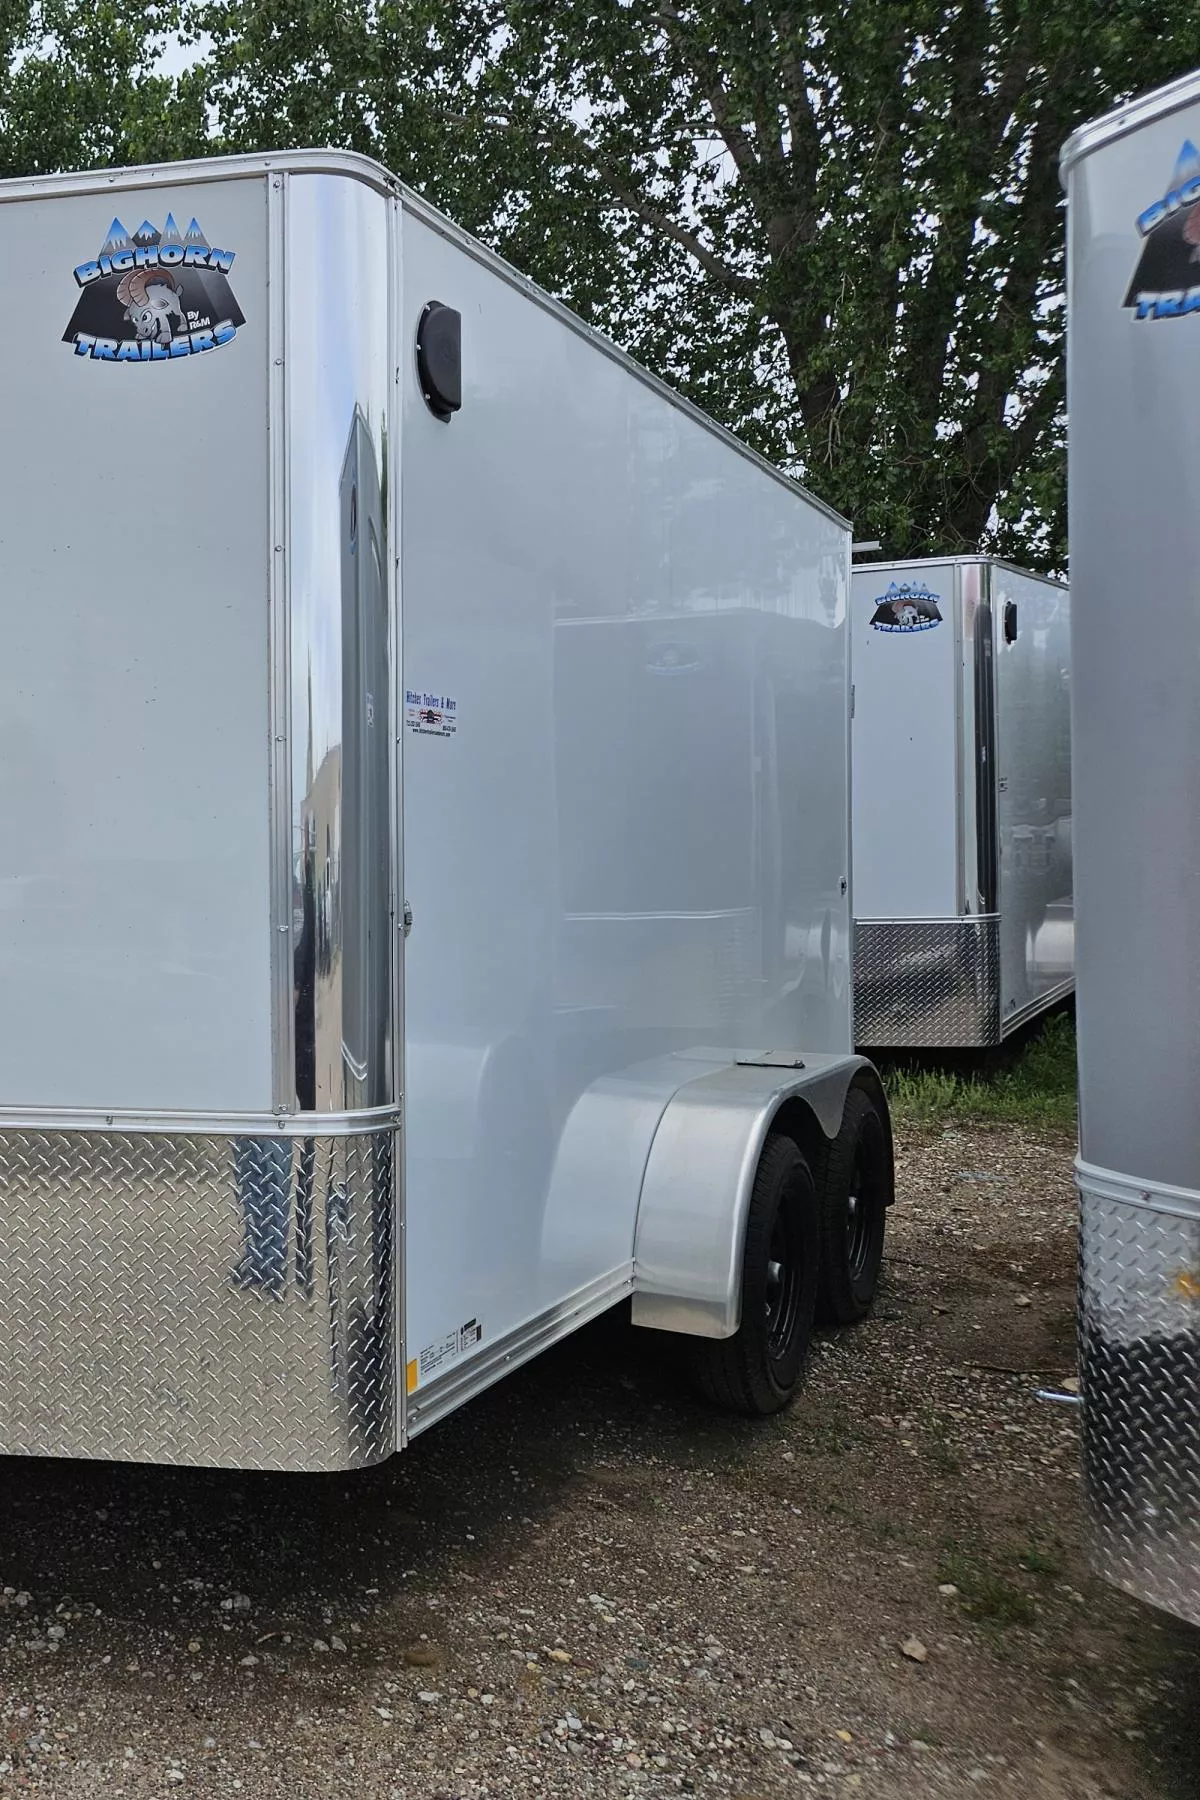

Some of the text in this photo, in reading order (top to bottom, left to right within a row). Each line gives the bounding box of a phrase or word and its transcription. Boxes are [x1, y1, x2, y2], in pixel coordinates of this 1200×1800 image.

[74, 245, 235, 287] BIGHORN
[187, 311, 199, 321] By
[189, 316, 210, 330] R&M
[74, 321, 237, 361] TRAILERS
[875, 592, 940, 605] BIGHORN
[874, 618, 939, 632] TRAILERS
[423, 693, 439, 708] Trailers
